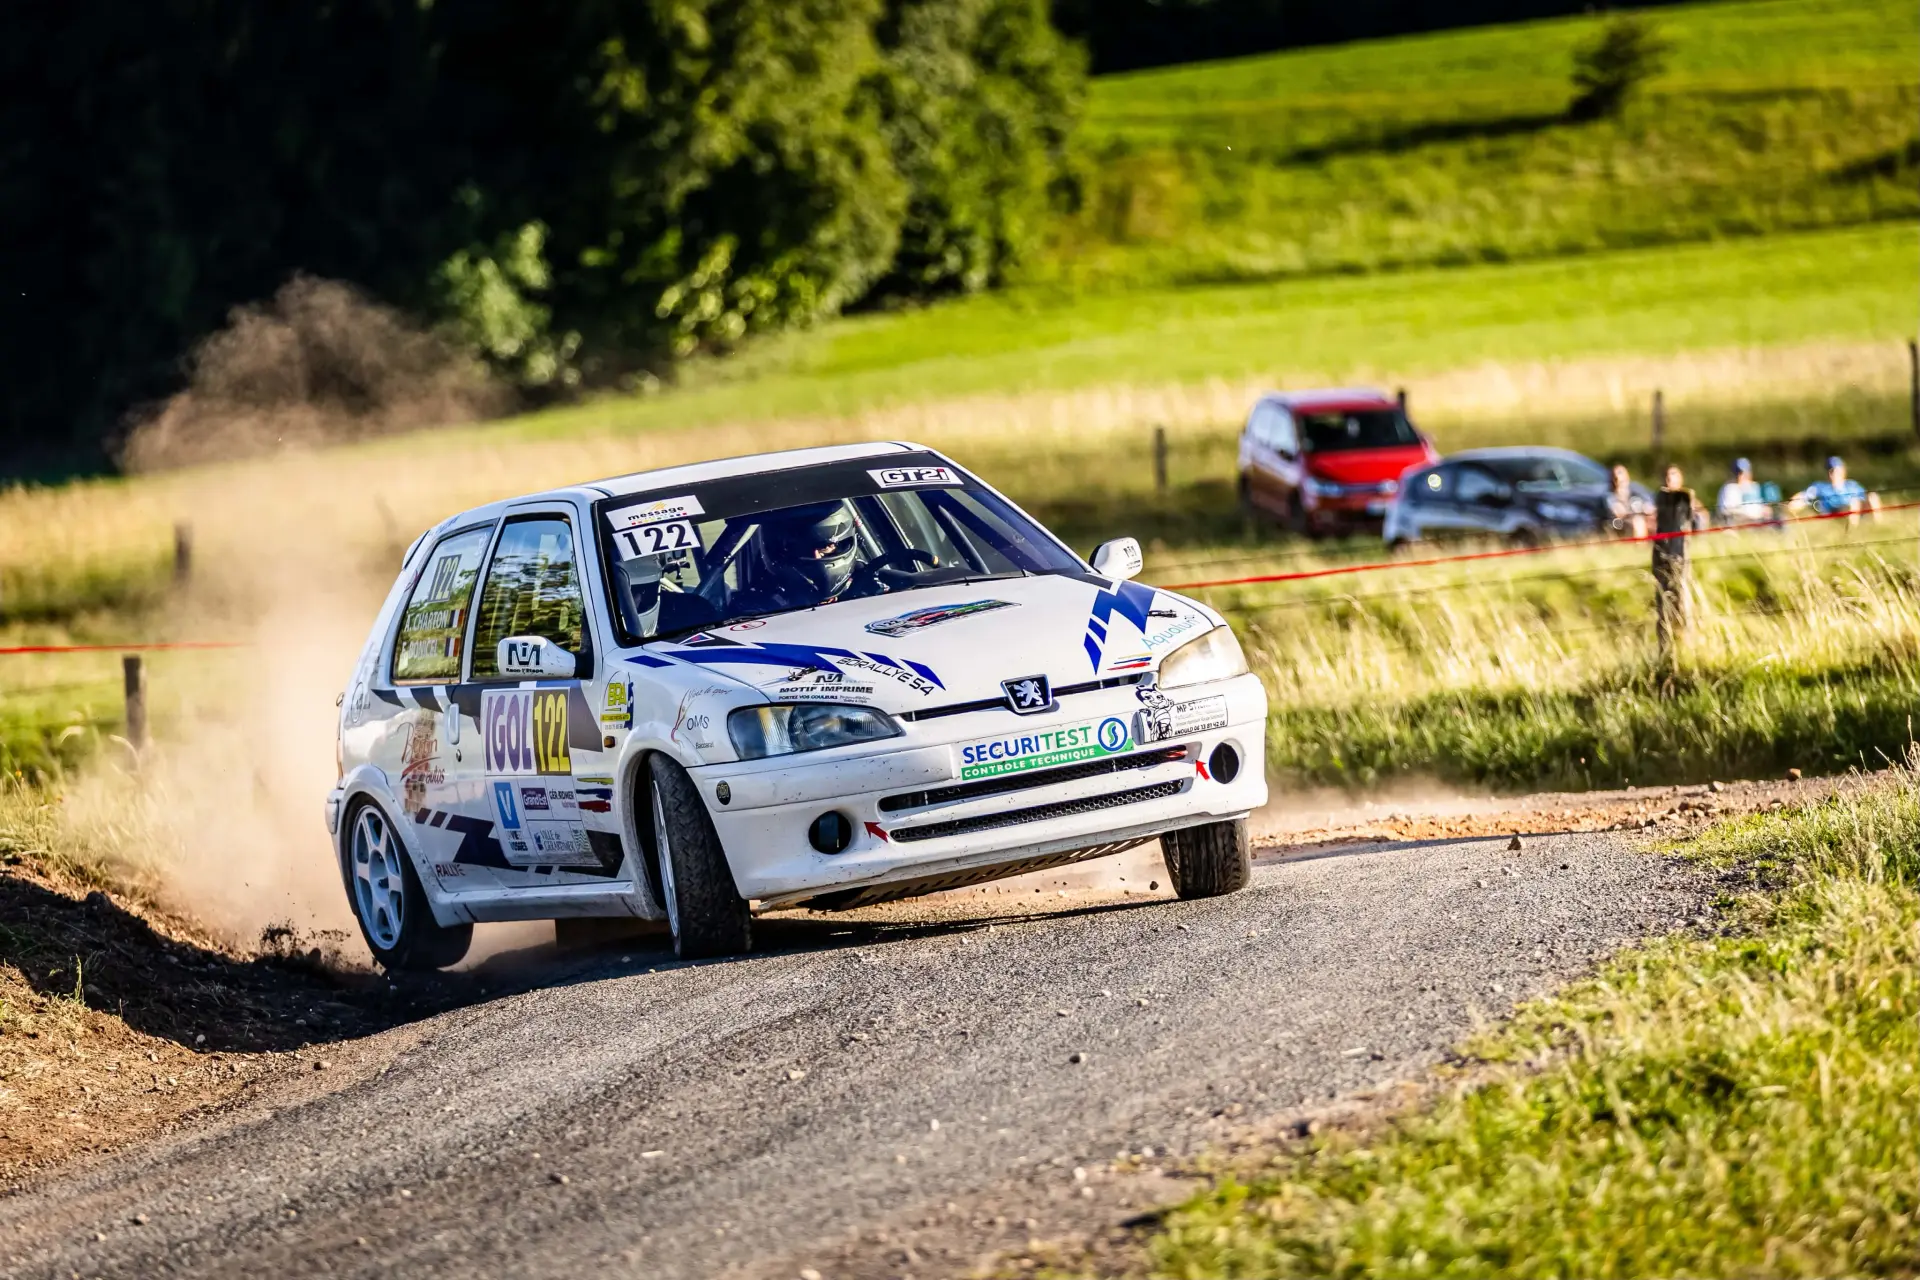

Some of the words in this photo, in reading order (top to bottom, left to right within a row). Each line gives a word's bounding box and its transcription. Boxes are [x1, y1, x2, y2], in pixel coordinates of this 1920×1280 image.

[880, 468, 950, 484] GT2i
[628, 506, 684, 521] message
[622, 523, 692, 556] 122
[429, 556, 459, 601] 122
[485, 694, 532, 773] IGOL
[534, 693, 570, 772] 122
[687, 714, 709, 730] OMS
[962, 726, 1092, 764] SECURITEST
[964, 760, 1026, 777] CONTROLE
[1030, 748, 1095, 767] TECHNIQUE
